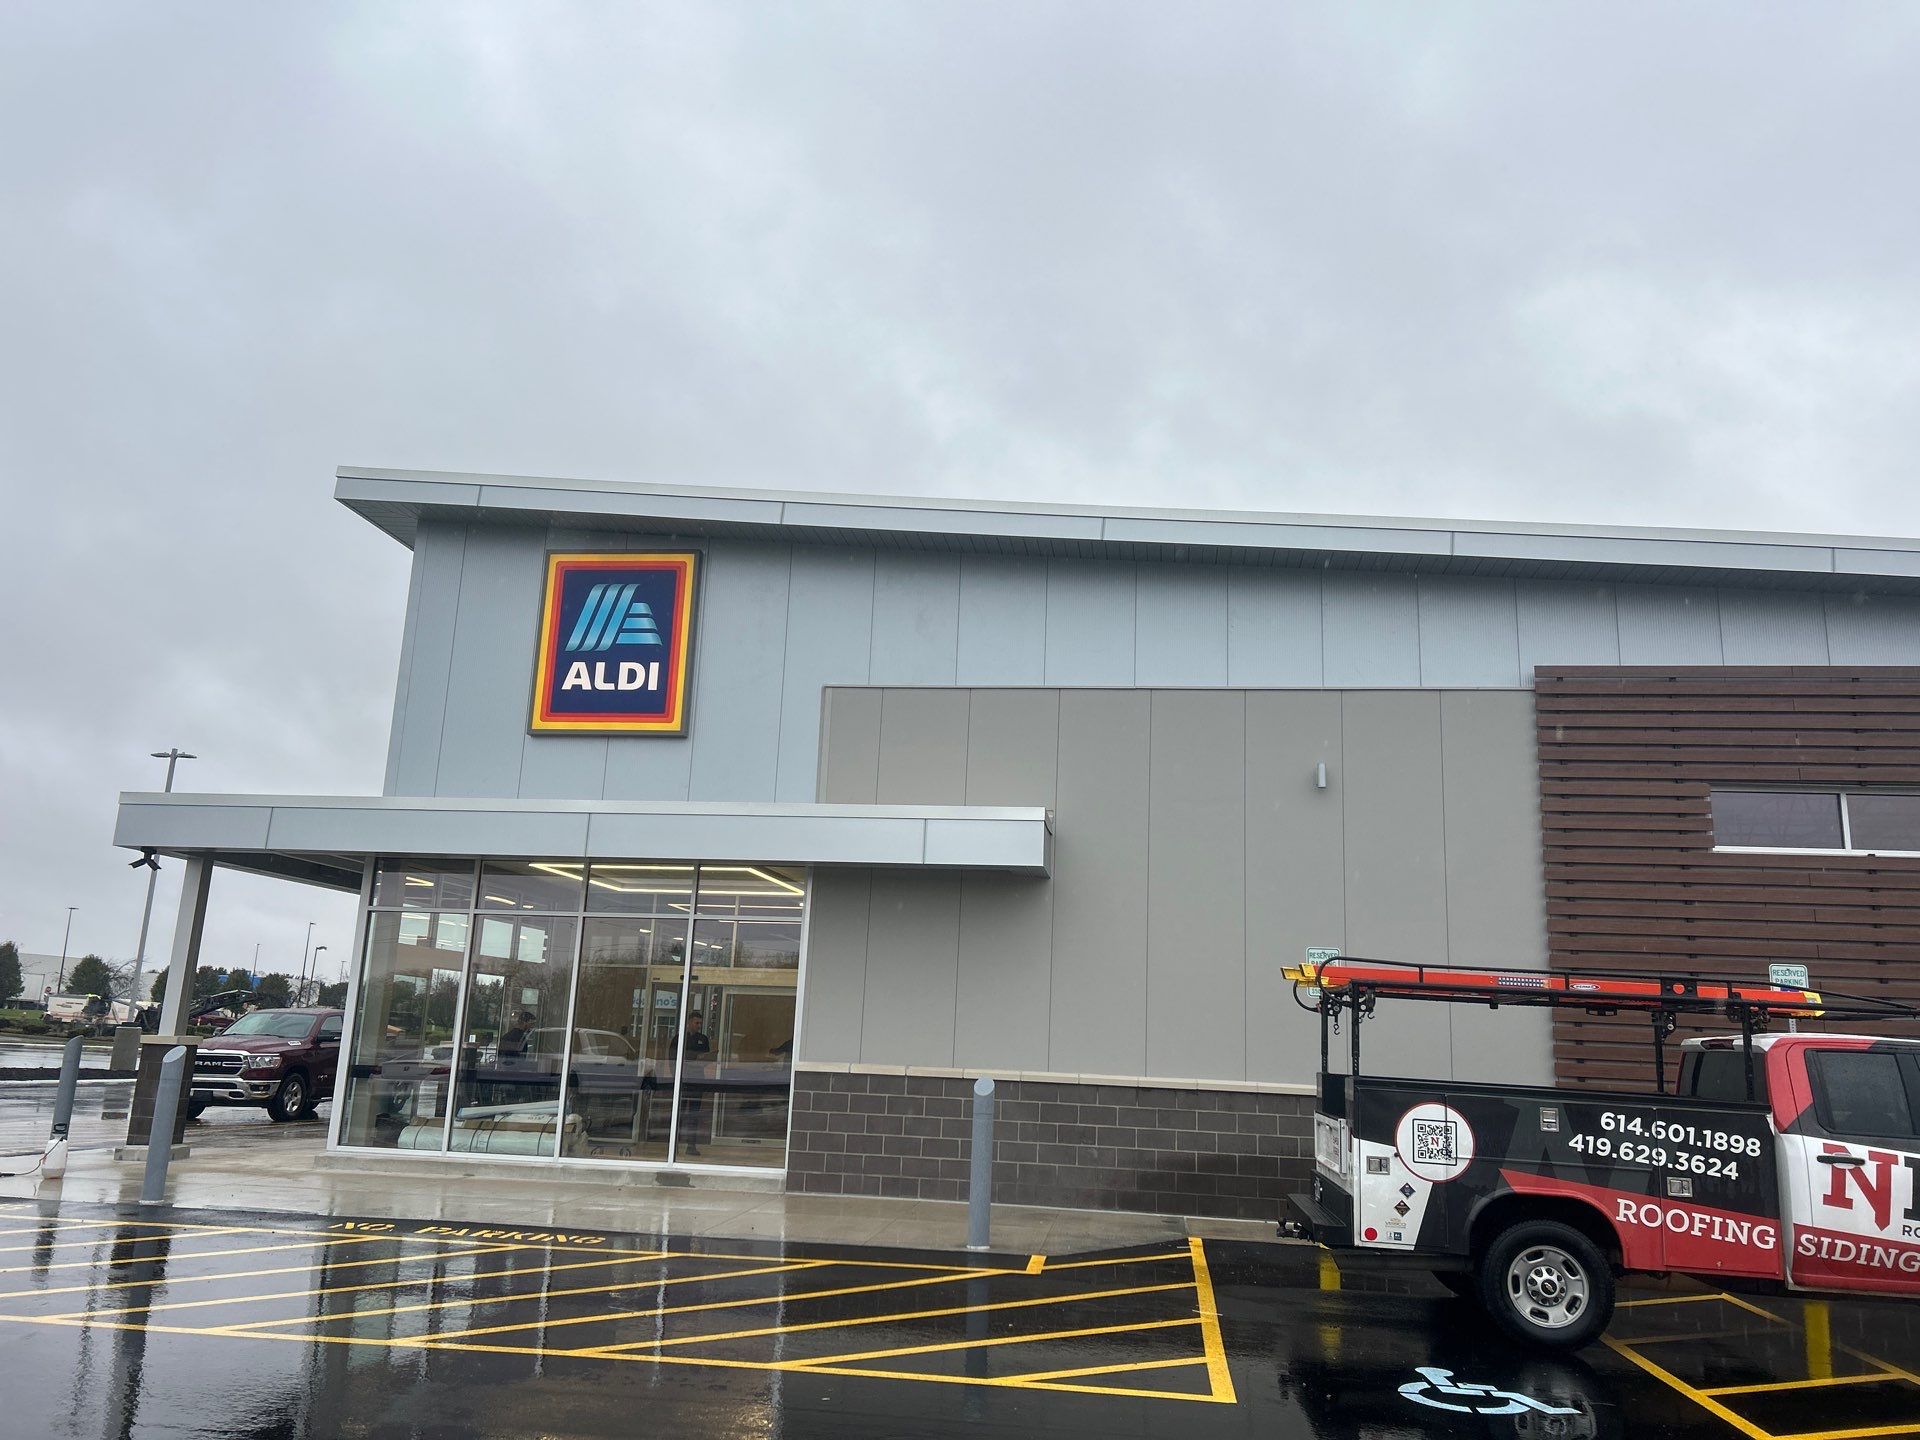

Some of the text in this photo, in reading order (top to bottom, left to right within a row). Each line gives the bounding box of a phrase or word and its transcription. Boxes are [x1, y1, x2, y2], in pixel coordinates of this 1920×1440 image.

[561, 661, 660, 691] ALDI
[1772, 969, 1805, 977] RESERVED
[1600, 1112, 1762, 1157] 614.601.1898
[1568, 1133, 1740, 1181] 419.629.3624
[327, 1222, 606, 1244] NO PARKING
[1615, 1198, 1777, 1250] ROOFING
[1797, 1233, 1920, 1273] SIDING
